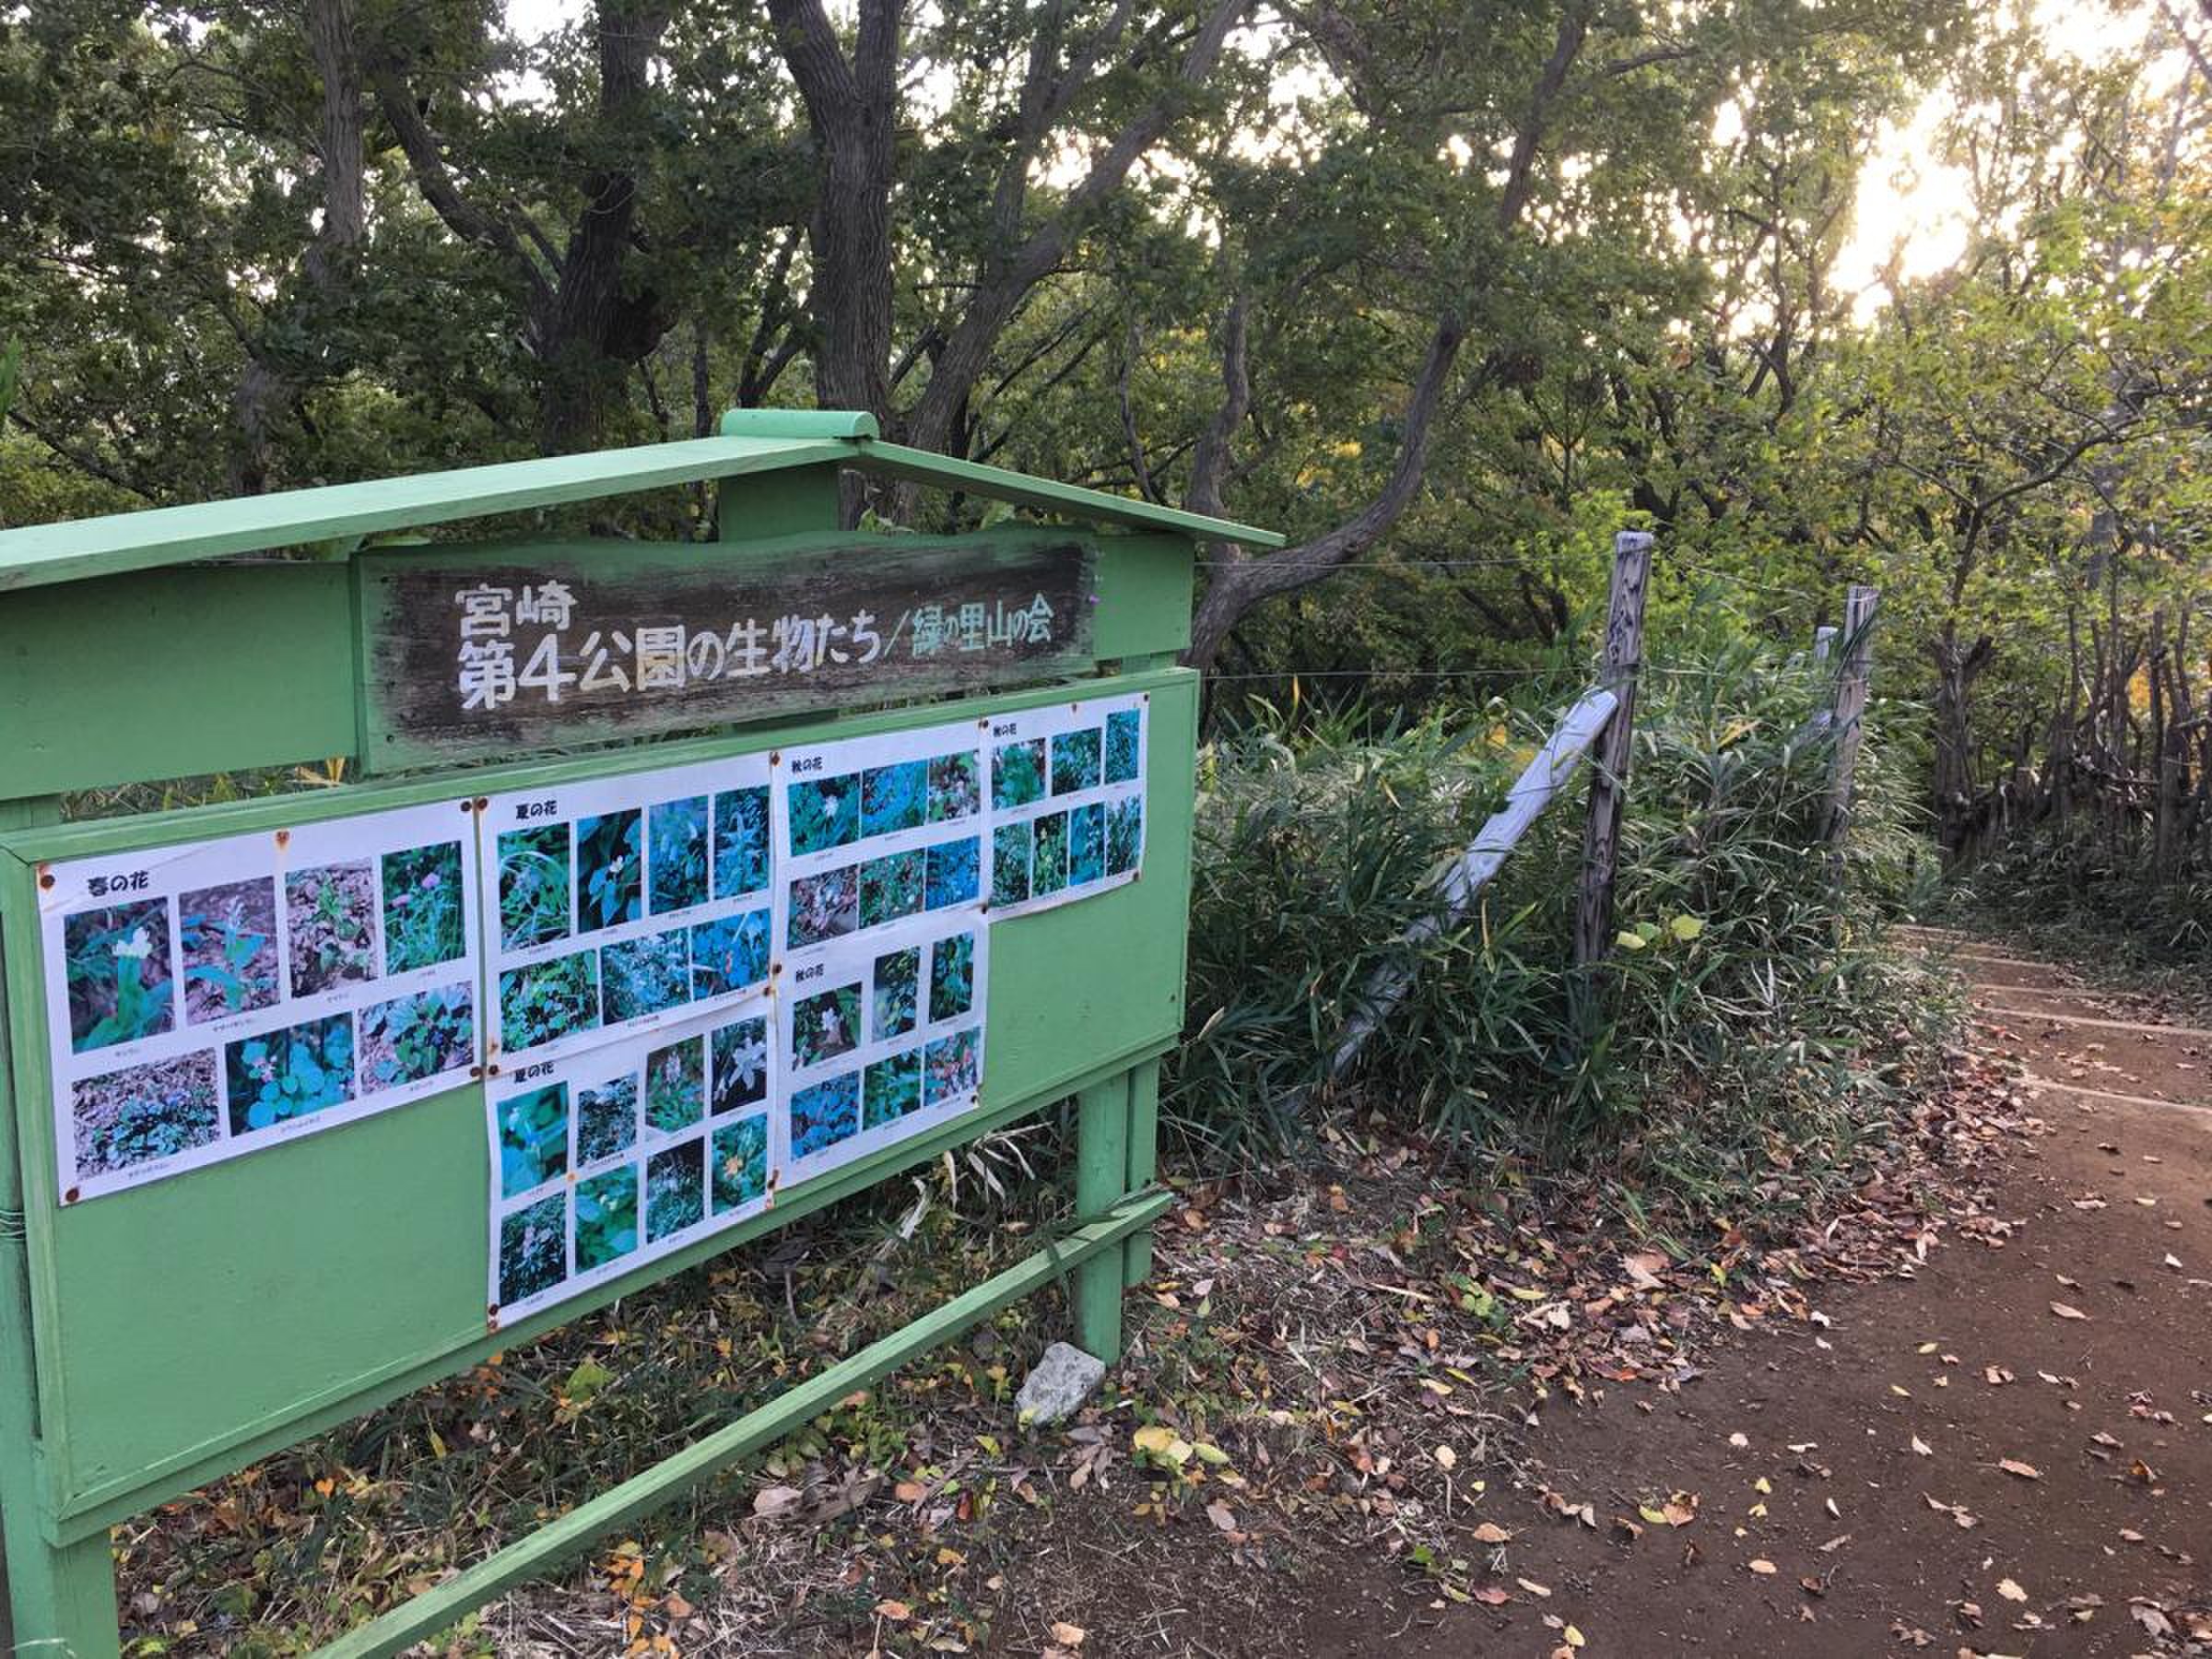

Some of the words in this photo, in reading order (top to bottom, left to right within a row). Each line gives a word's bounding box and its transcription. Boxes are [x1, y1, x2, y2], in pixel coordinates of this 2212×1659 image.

[515, 800, 558, 819] 夏の花
[88, 870, 148, 897] 春の花
